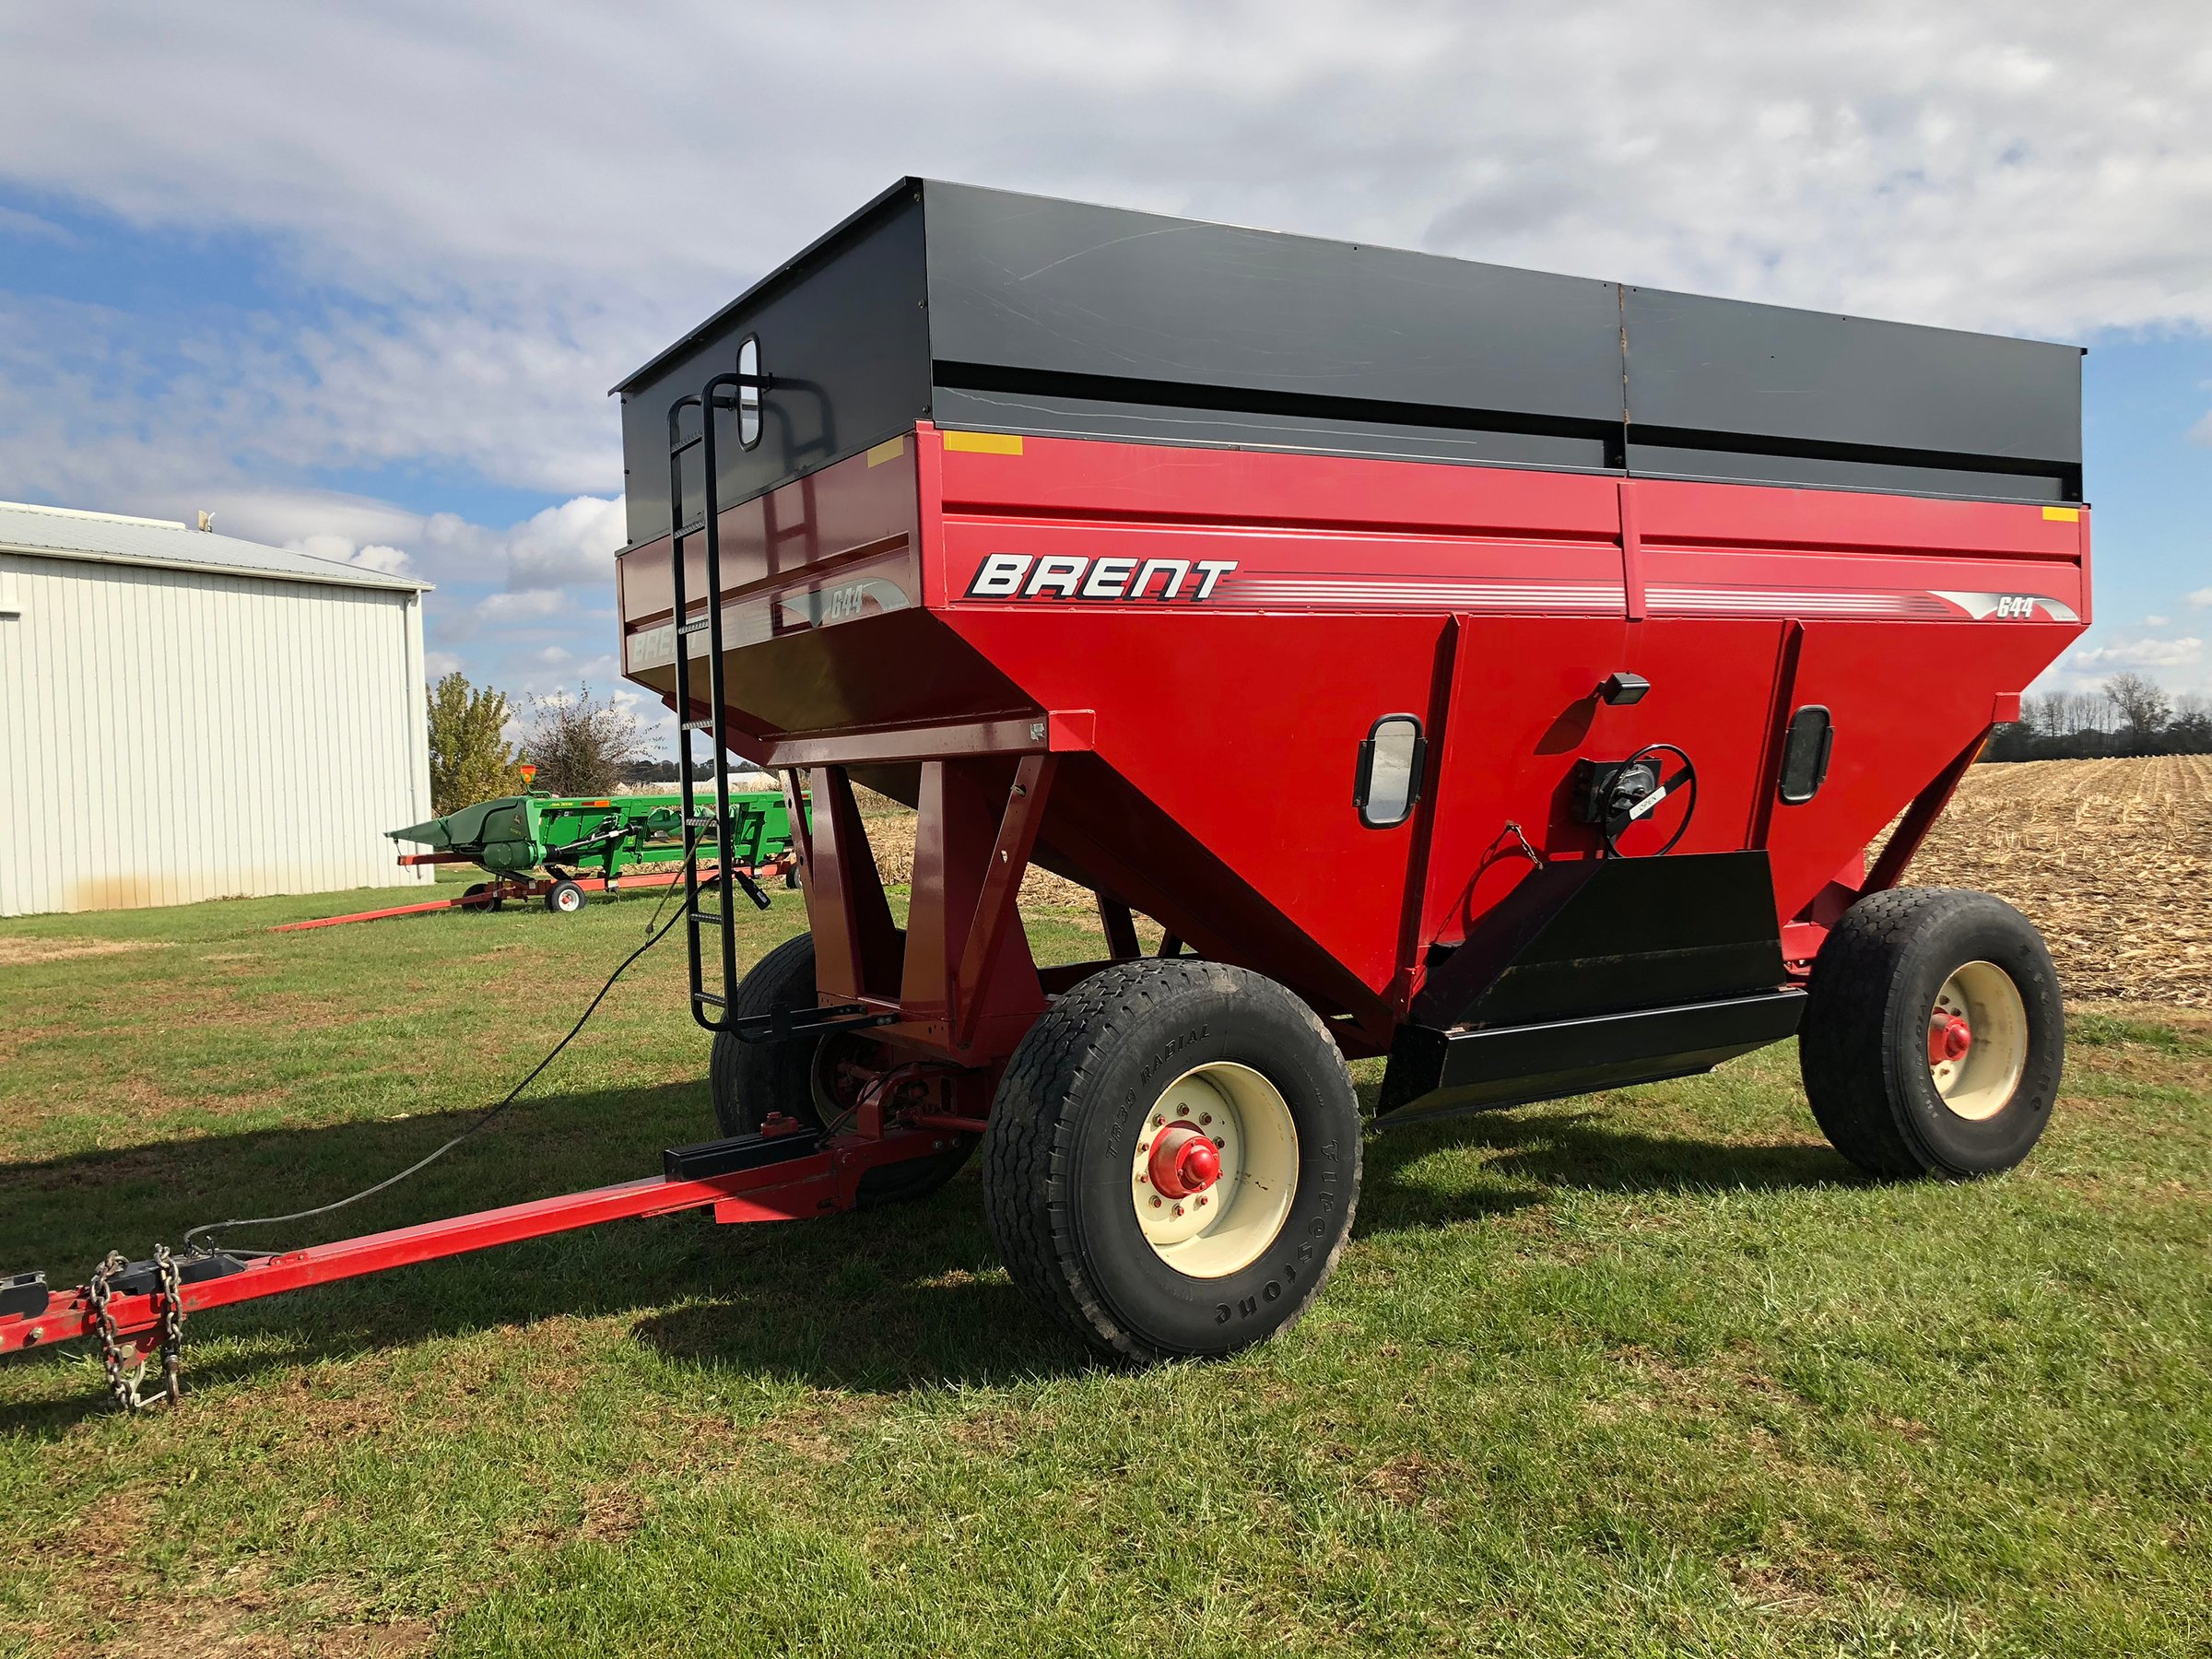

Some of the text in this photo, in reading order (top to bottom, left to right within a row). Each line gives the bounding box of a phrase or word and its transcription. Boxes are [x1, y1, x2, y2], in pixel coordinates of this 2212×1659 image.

[963, 552, 1240, 601] BRENT
[831, 583, 864, 619] 644
[1996, 596, 2034, 618] 644
[632, 626, 700, 663] BRET
[1106, 1023, 1210, 1159] TR39 RADIAL
